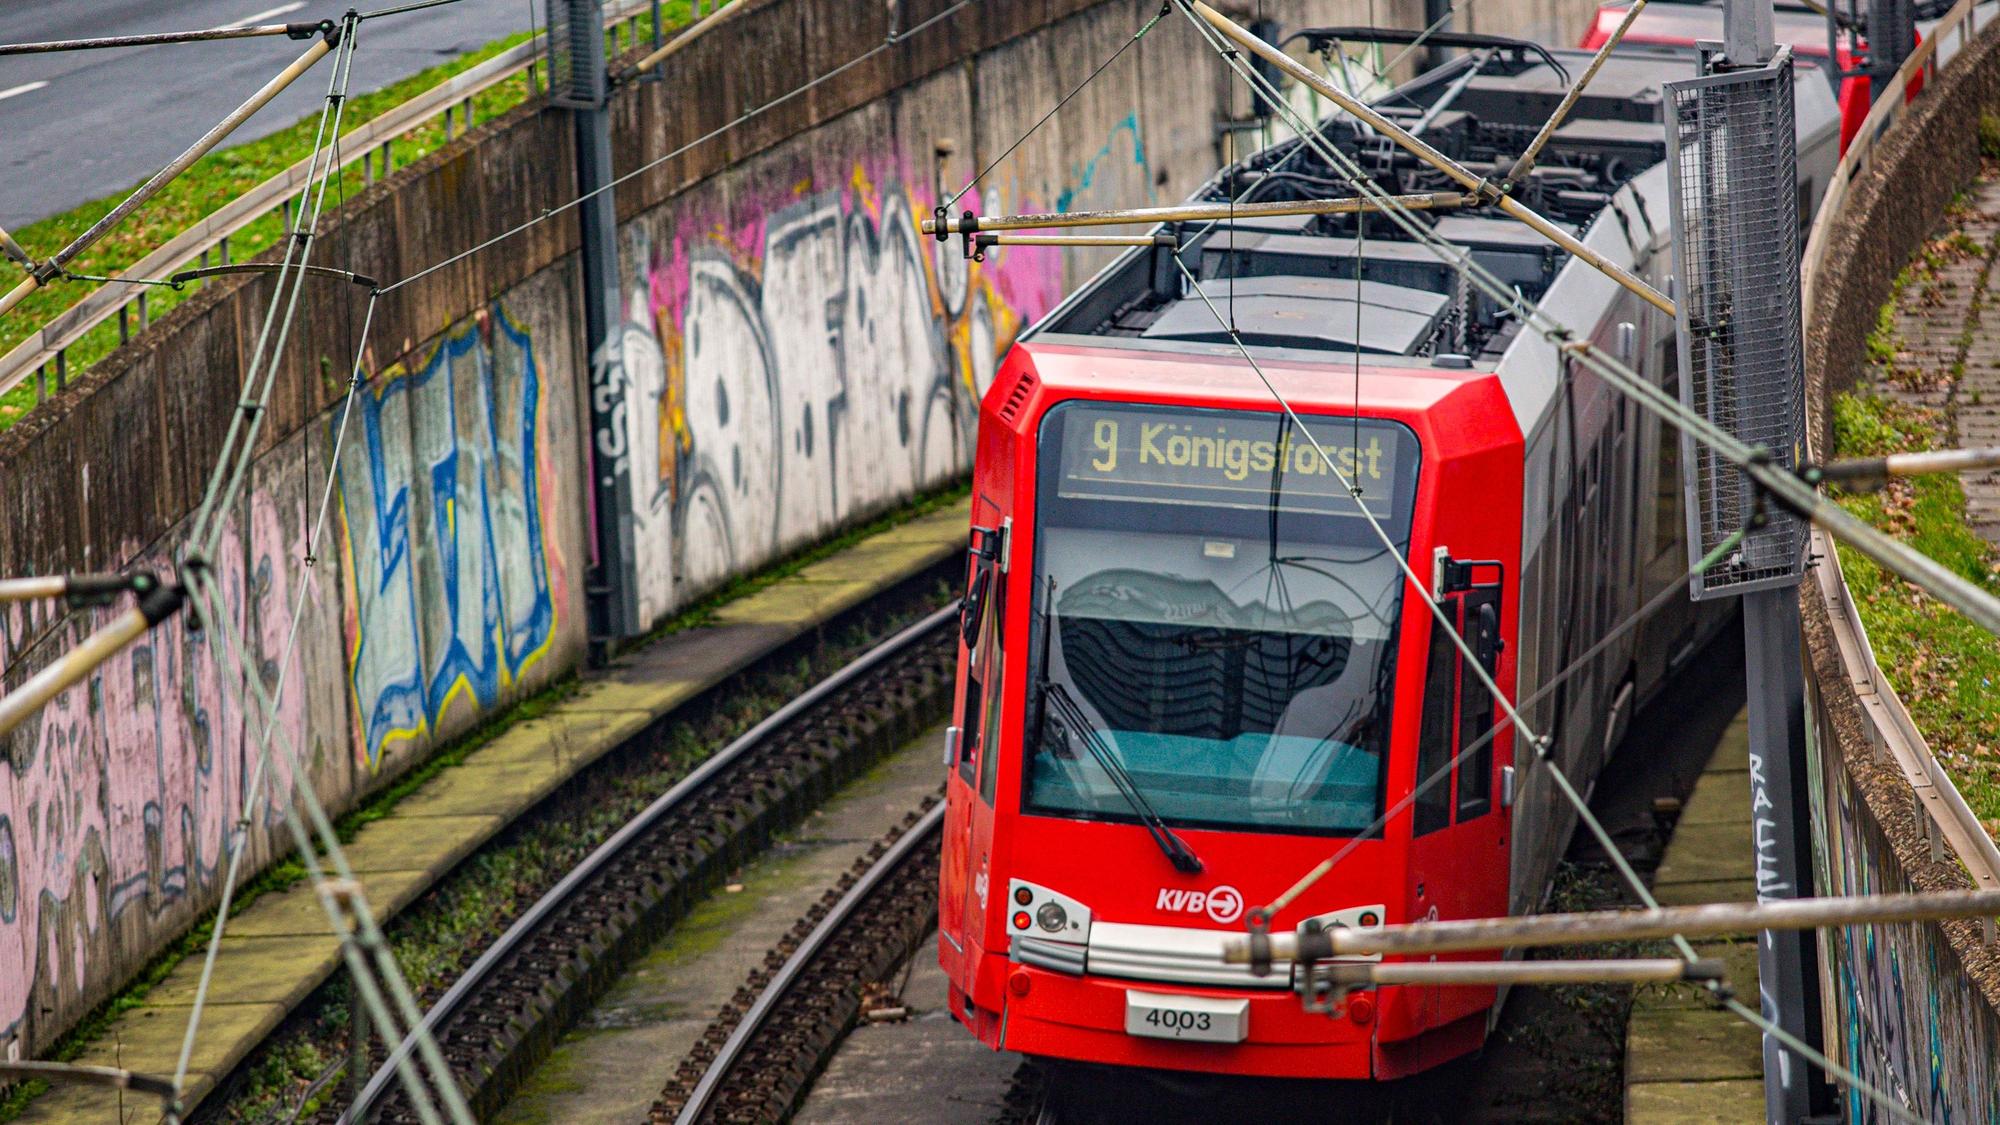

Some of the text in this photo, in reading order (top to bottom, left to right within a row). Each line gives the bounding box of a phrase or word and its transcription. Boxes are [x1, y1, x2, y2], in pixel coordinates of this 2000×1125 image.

[1092, 419, 1382, 480] 9 Königsforst
[1156, 888, 1207, 913] KVB
[1146, 1009, 1211, 1031] 4003
